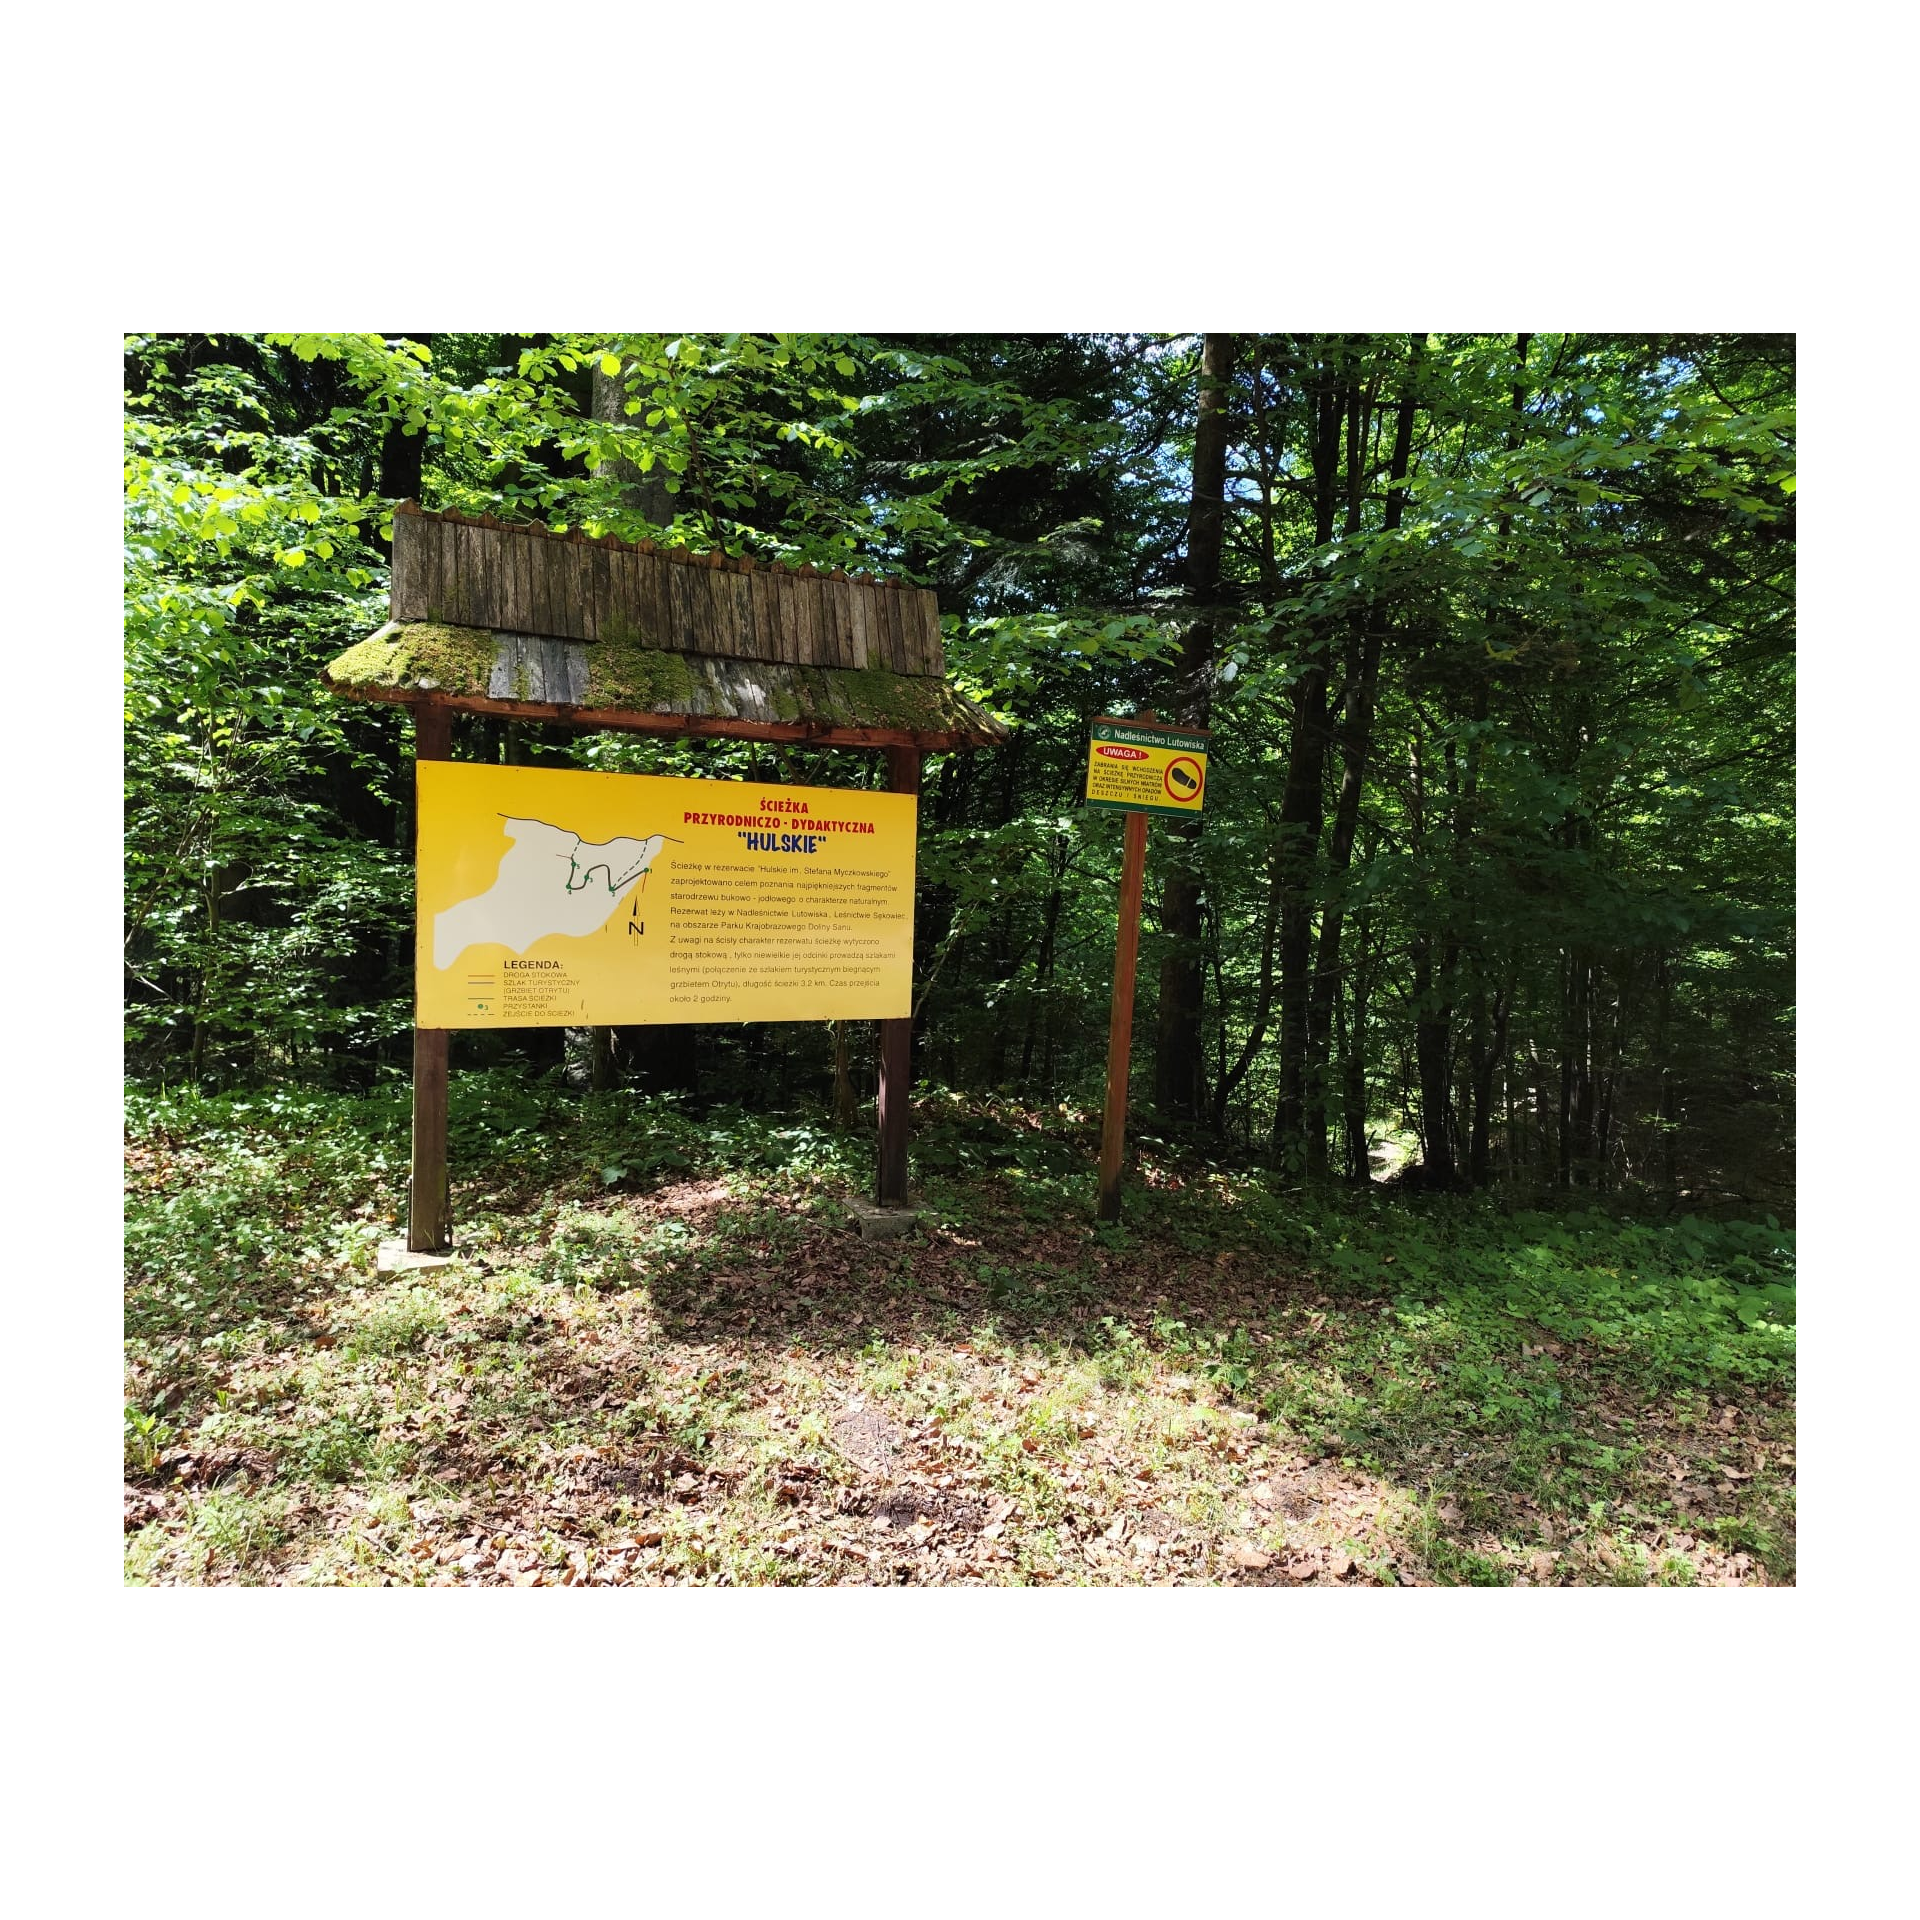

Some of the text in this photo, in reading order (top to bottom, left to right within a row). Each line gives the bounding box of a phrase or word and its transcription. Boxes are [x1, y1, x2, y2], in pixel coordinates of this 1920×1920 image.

[1114, 729, 1165, 745] Nadleśnictwo
[1167, 737, 1204, 749] Lutowiska
[1103, 748, 1137, 759] UWAGA
[760, 797, 809, 814] ŚCIEŻKA
[684, 812, 780, 829] PRZYRODNICZO
[792, 818, 875, 834] DYDAKTYCZNA
[738, 831, 827, 854] "HULSKIE"
[714, 864, 755, 872] rezerwacie
[804, 867, 831, 875] Stefana
[671, 878, 732, 886] zaprojektowano
[797, 882, 854, 891] najpiękniejszych
[857, 884, 897, 892] fragmentów
[670, 893, 718, 901] starodrzewu
[806, 896, 847, 904] charakterze
[670, 907, 708, 915] Rezerwat
[737, 909, 788, 917] Nadleśnictwie
[834, 911, 870, 919] Leśnictwie
[629, 921, 644, 935] N
[683, 921, 718, 929] obszarze
[746, 922, 806, 931] Krajobrazowego
[808, 923, 830, 931] Doliny
[678, 936, 701, 945] uwagi
[670, 952, 692, 960] drogą
[830, 952, 863, 960] prowadzą
[504, 960, 563, 969] LEGENDA:
[670, 966, 700, 974] leśnymi
[842, 966, 880, 974] biegnącym
[670, 981, 709, 989] grzbietem
[850, 980, 879, 988] przejścia
[701, 995, 732, 1003] godziny.
